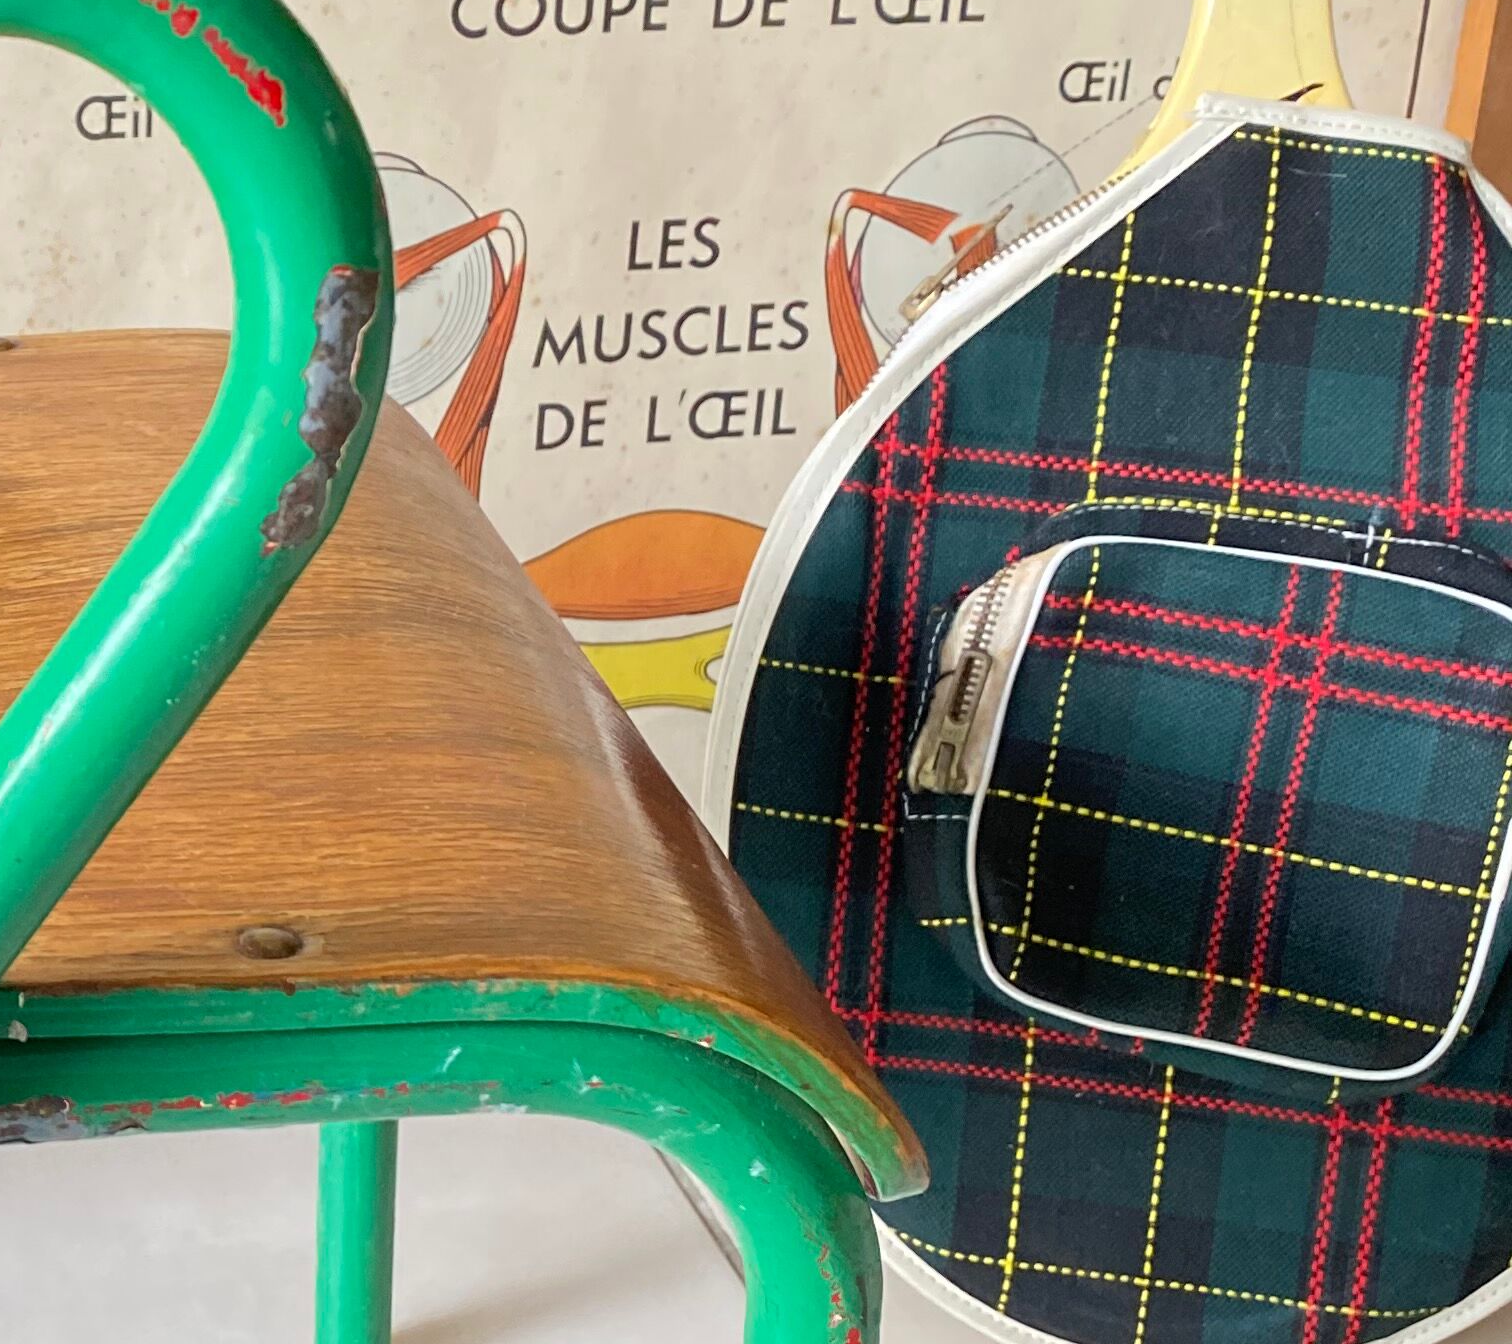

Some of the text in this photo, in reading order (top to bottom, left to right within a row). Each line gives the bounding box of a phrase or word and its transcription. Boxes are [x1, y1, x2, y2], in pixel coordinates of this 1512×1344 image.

[1056, 56, 1133, 105] Œil
[73, 92, 156, 142] Œil
[627, 216, 721, 272] LES
[532, 299, 809, 369] MUSCLES
[534, 387, 797, 452] DE L'ŒIL
